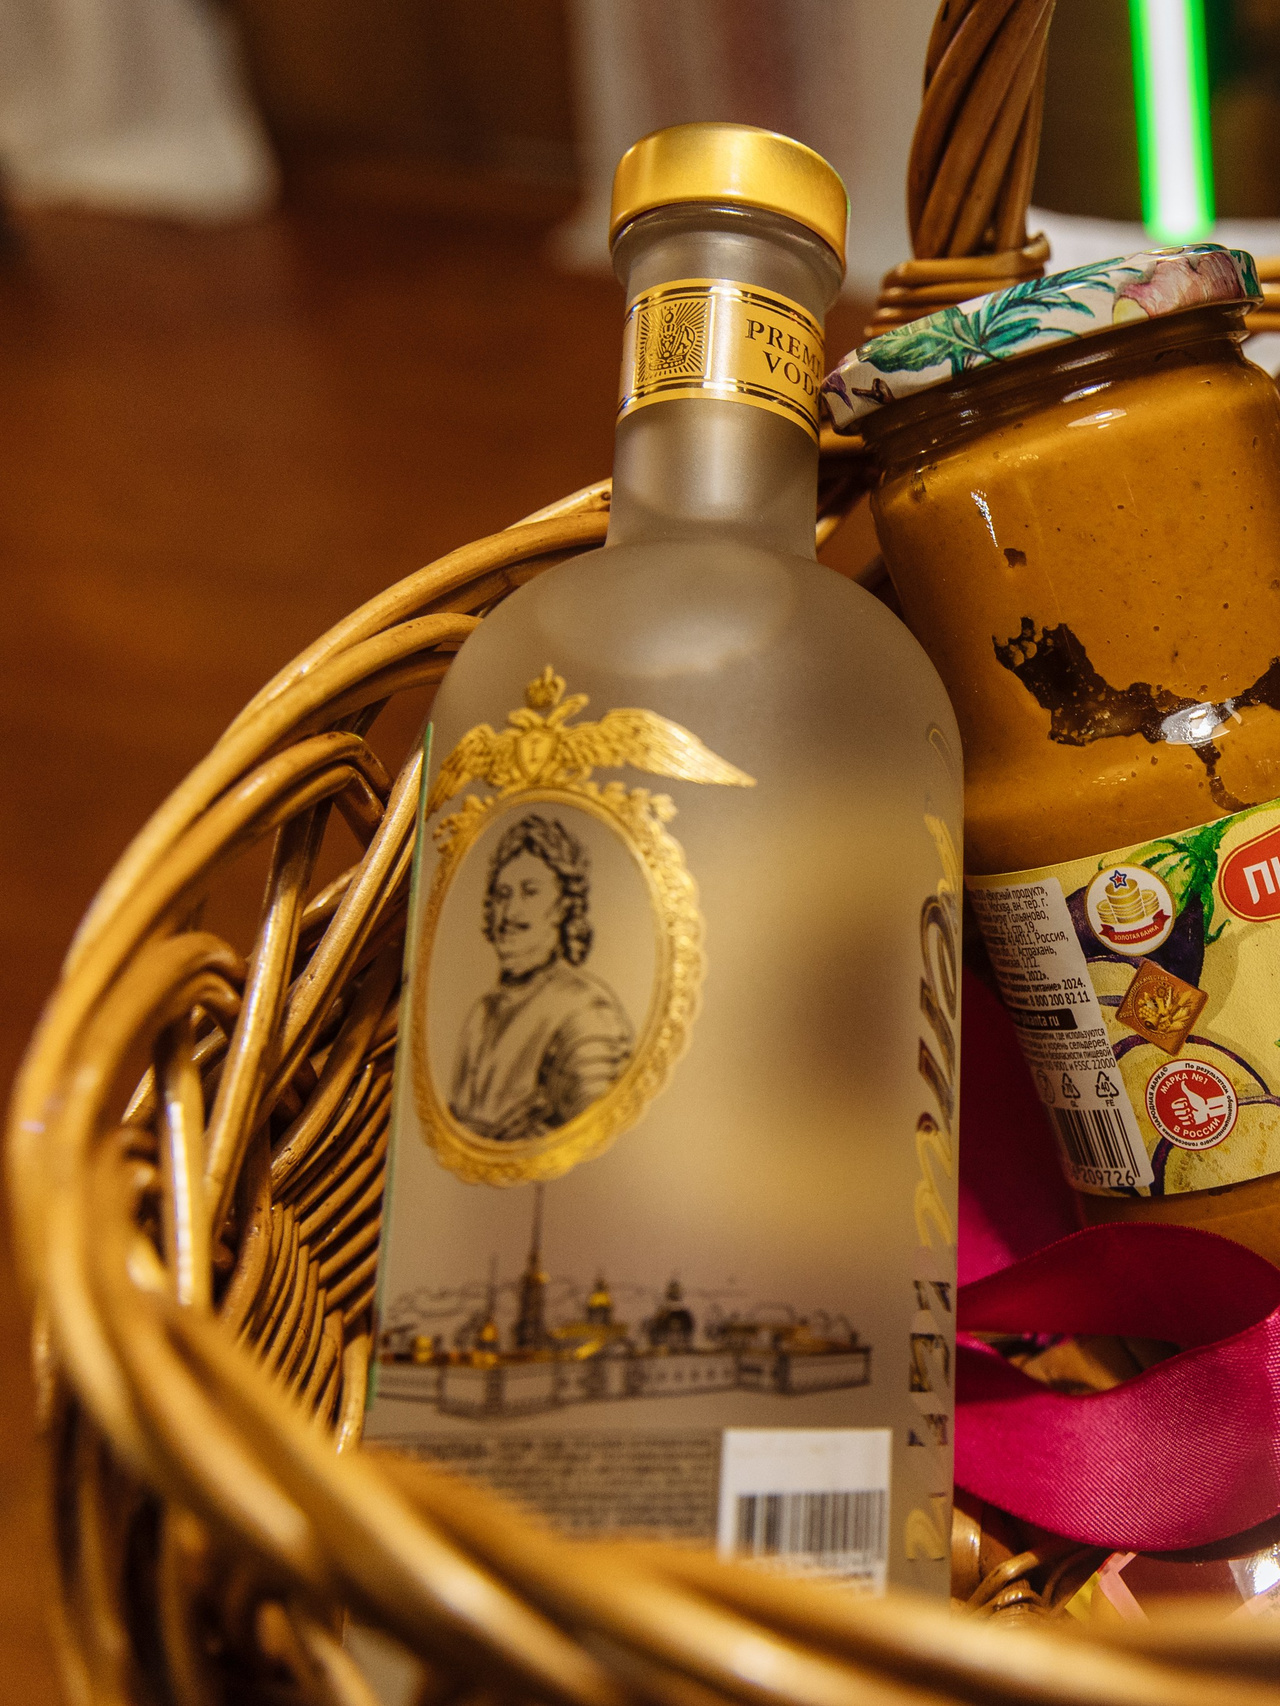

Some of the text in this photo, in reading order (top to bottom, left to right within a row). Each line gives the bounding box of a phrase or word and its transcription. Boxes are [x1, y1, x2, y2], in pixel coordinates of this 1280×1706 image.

[744, 318, 821, 379] PREMI
[761, 350, 818, 402] VOD
[1024, 899, 1041, 911] тер.
[1035, 931, 1069, 945] Россия,
[1114, 925, 1160, 941] ЗОЛОТАЯ БАНКА
[1062, 978, 1087, 990] 2024.
[1048, 993, 1065, 1006] 200
[1065, 991, 1077, 1004] 82
[1077, 990, 1091, 1004] 11
[1069, 1039, 1109, 1050] сельдерея.
[1092, 1058, 1116, 1069] 22000
[1160, 1072, 1209, 1095] МАРКА №1
[1148, 1092, 1163, 1129] НАРОДНАЯ
[1173, 1117, 1221, 1138] В РОССИИ
